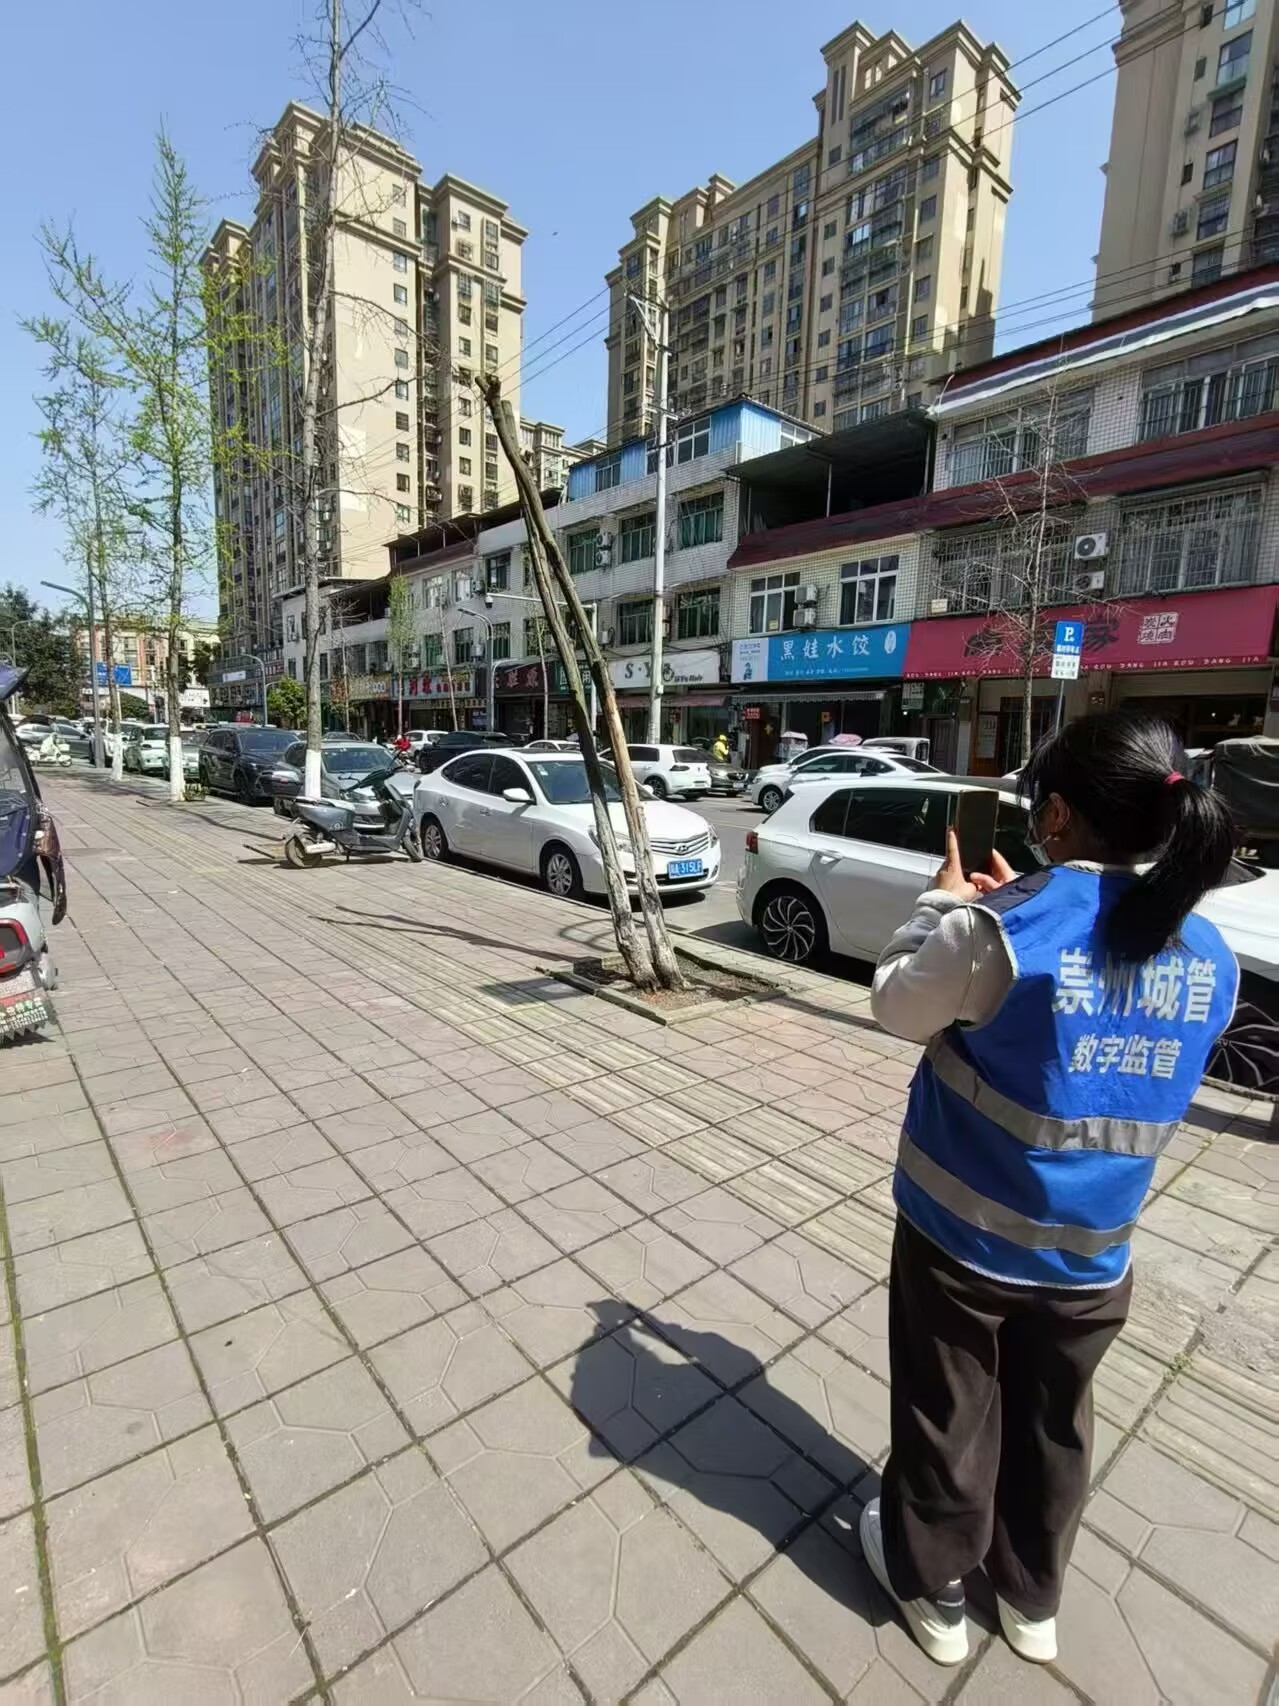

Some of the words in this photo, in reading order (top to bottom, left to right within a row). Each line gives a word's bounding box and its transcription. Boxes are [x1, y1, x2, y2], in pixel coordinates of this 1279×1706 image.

[780, 634, 871, 661] 黑娃水饺
[1052, 947, 1217, 1023] 崇州城管
[1068, 1033, 1183, 1080] 数字监管
